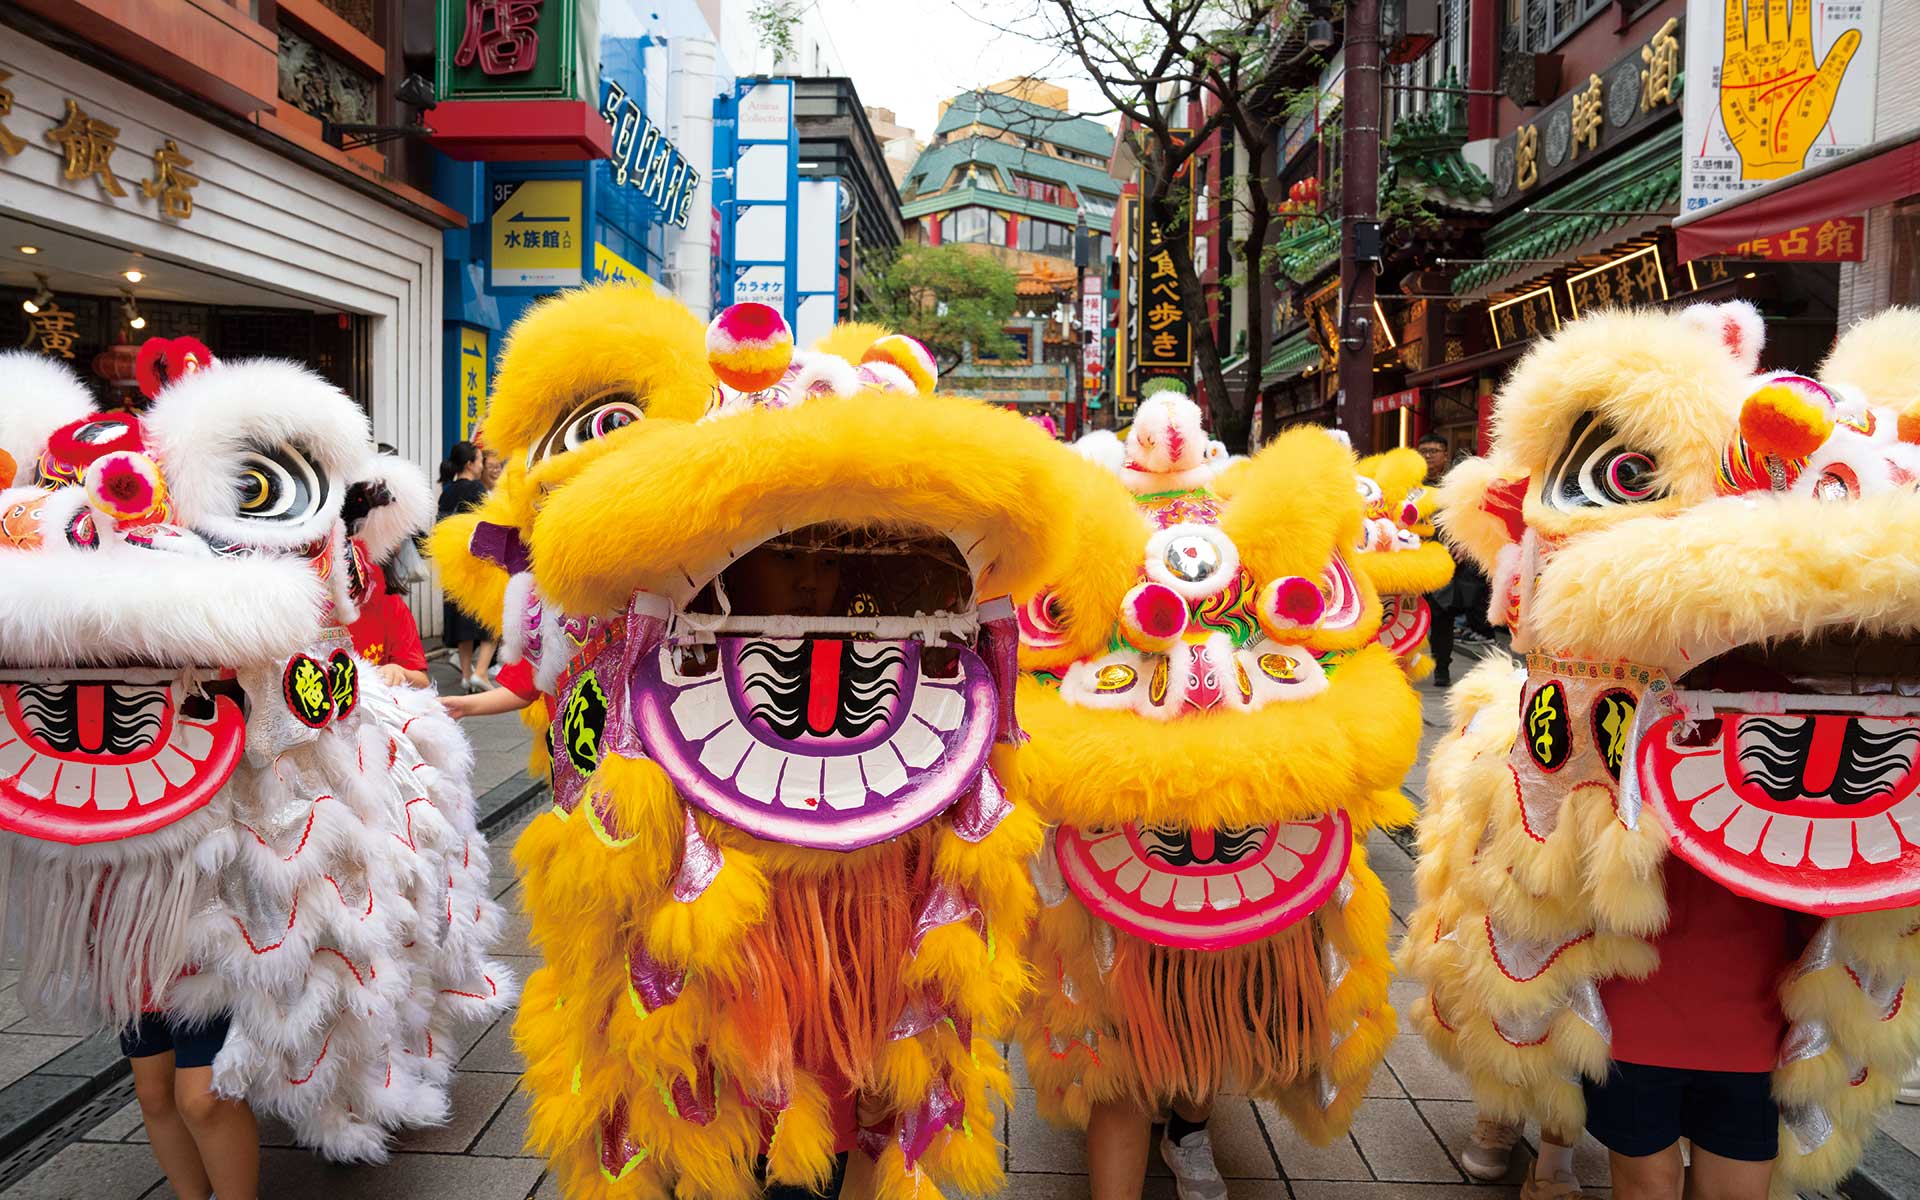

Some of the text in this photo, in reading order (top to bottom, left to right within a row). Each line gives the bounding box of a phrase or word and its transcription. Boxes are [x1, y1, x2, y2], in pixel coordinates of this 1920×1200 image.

[740, 112, 787, 123] Collection
[602, 81, 701, 230] SQUARE
[494, 184, 513, 202] 3F
[503, 229, 560, 249] 水族館
[562, 230, 572, 249] 入口
[736, 281, 784, 293] カラオケ
[1147, 220, 1184, 358] 食べ歩き
